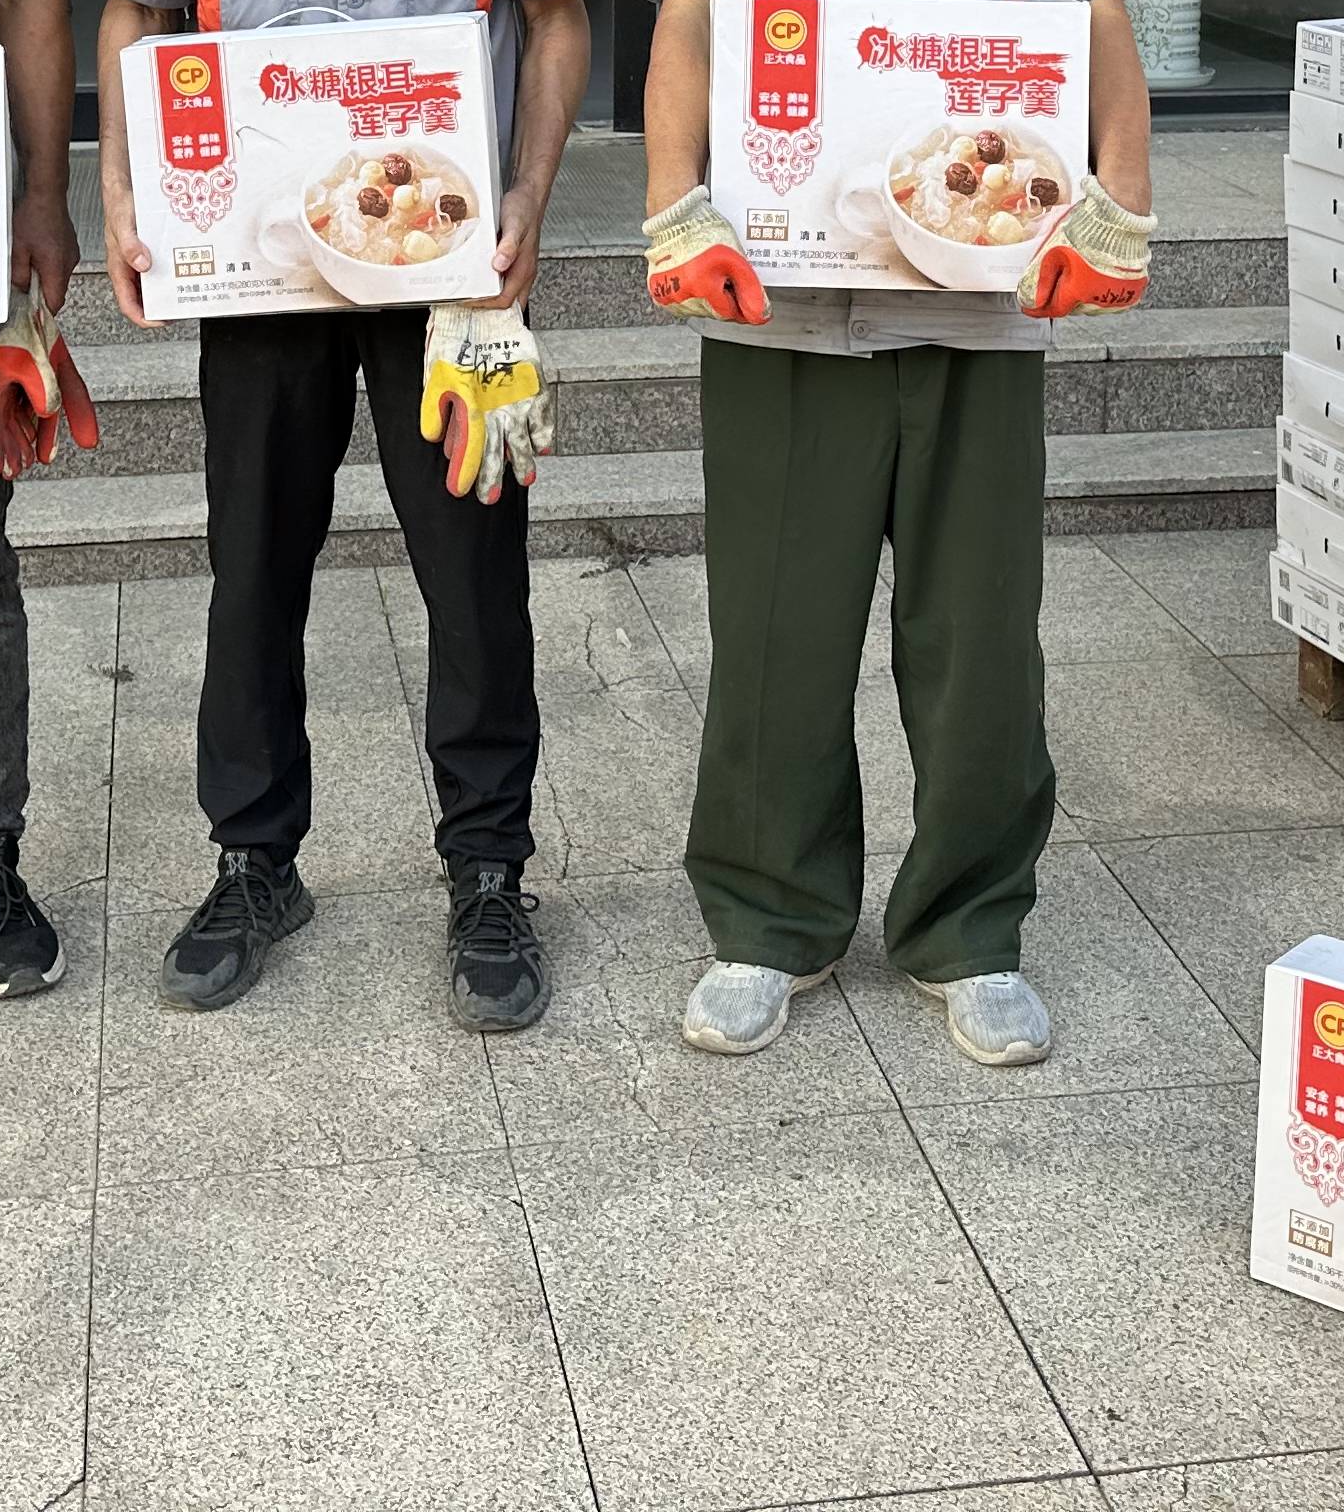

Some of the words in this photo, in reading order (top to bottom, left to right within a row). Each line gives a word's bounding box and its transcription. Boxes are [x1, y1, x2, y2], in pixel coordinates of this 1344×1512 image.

[771, 23, 800, 39] CP
[764, 52, 806, 66] 正大食品
[868, 34, 1022, 72] 冰糖银耳
[175, 68, 203, 84] CP
[272, 60, 415, 104] 冰糖银耳
[172, 96, 213, 110] 正大食品
[946, 79, 1059, 117] 莲子羹
[350, 99, 456, 140] 莲子羹
